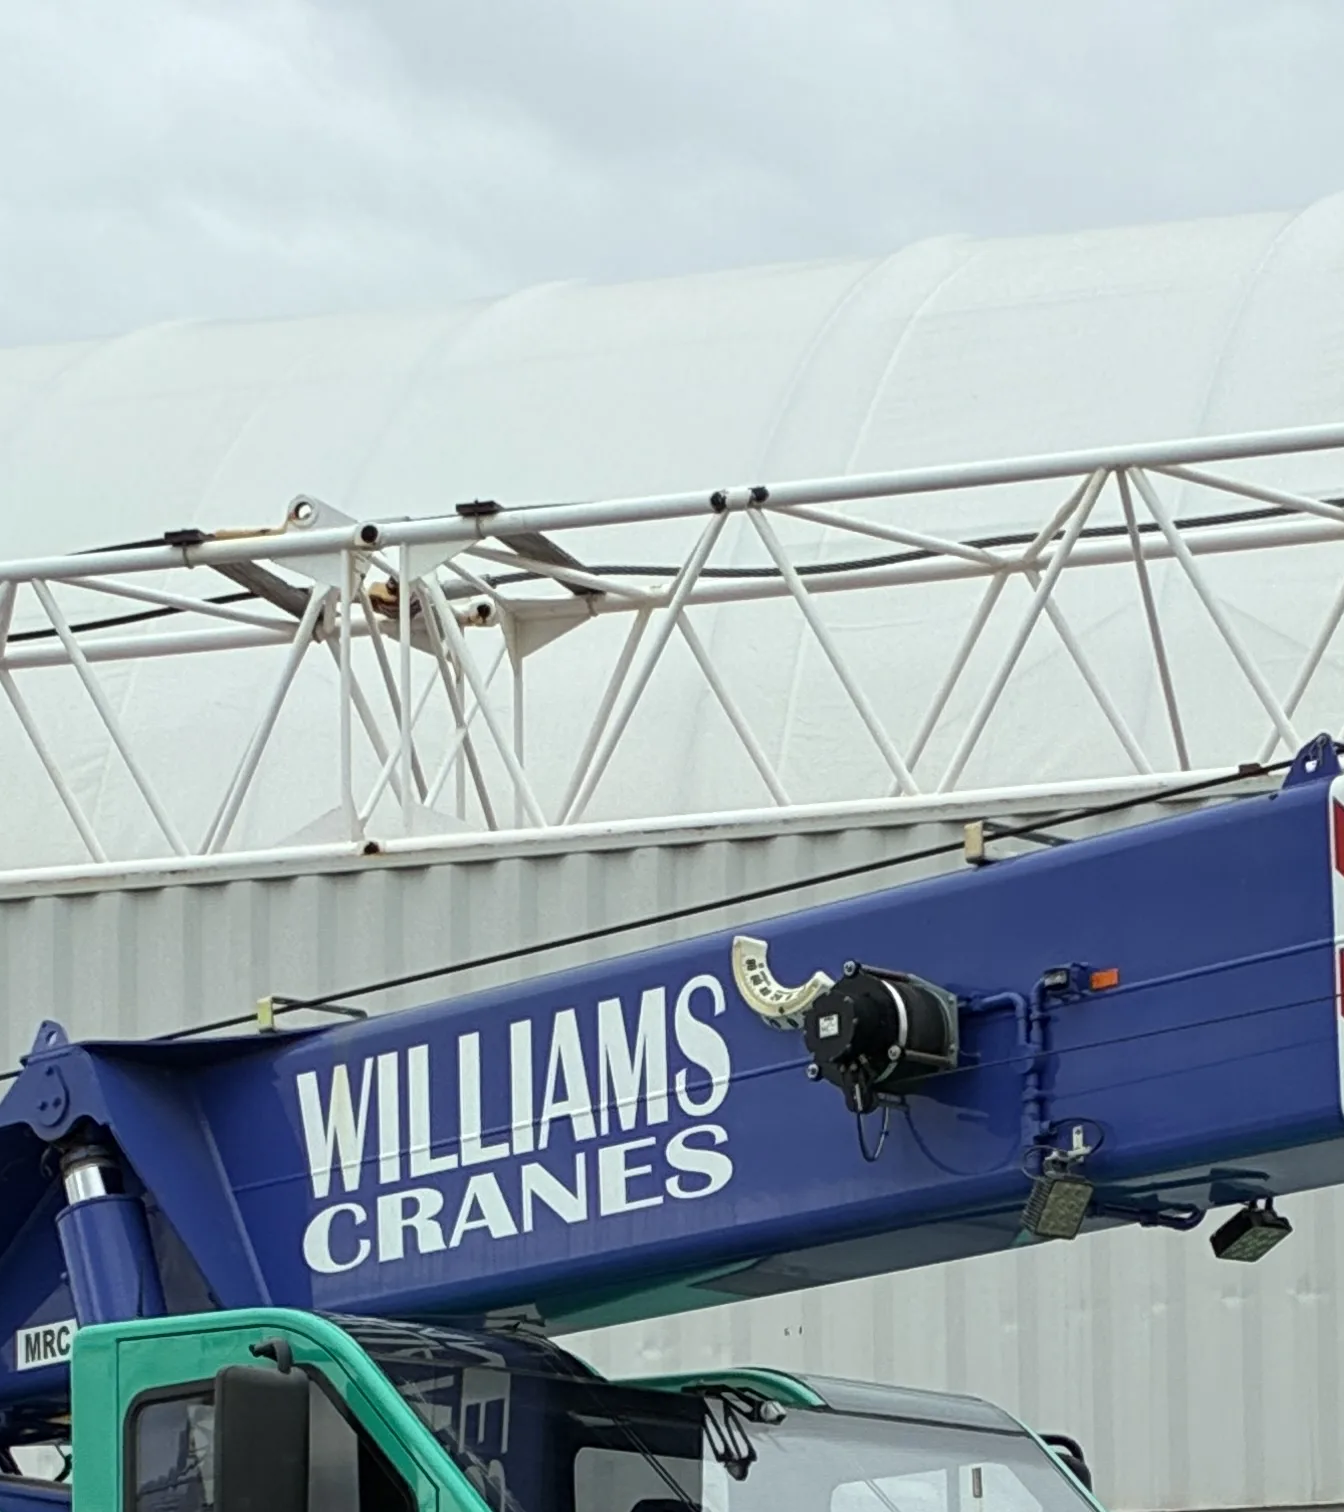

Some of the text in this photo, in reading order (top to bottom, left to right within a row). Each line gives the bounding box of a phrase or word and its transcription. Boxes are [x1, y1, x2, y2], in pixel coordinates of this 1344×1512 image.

[297, 974, 731, 1199] WILLIAMS
[302, 1125, 734, 1275] CRANES
[25, 1326, 71, 1364] MRC
